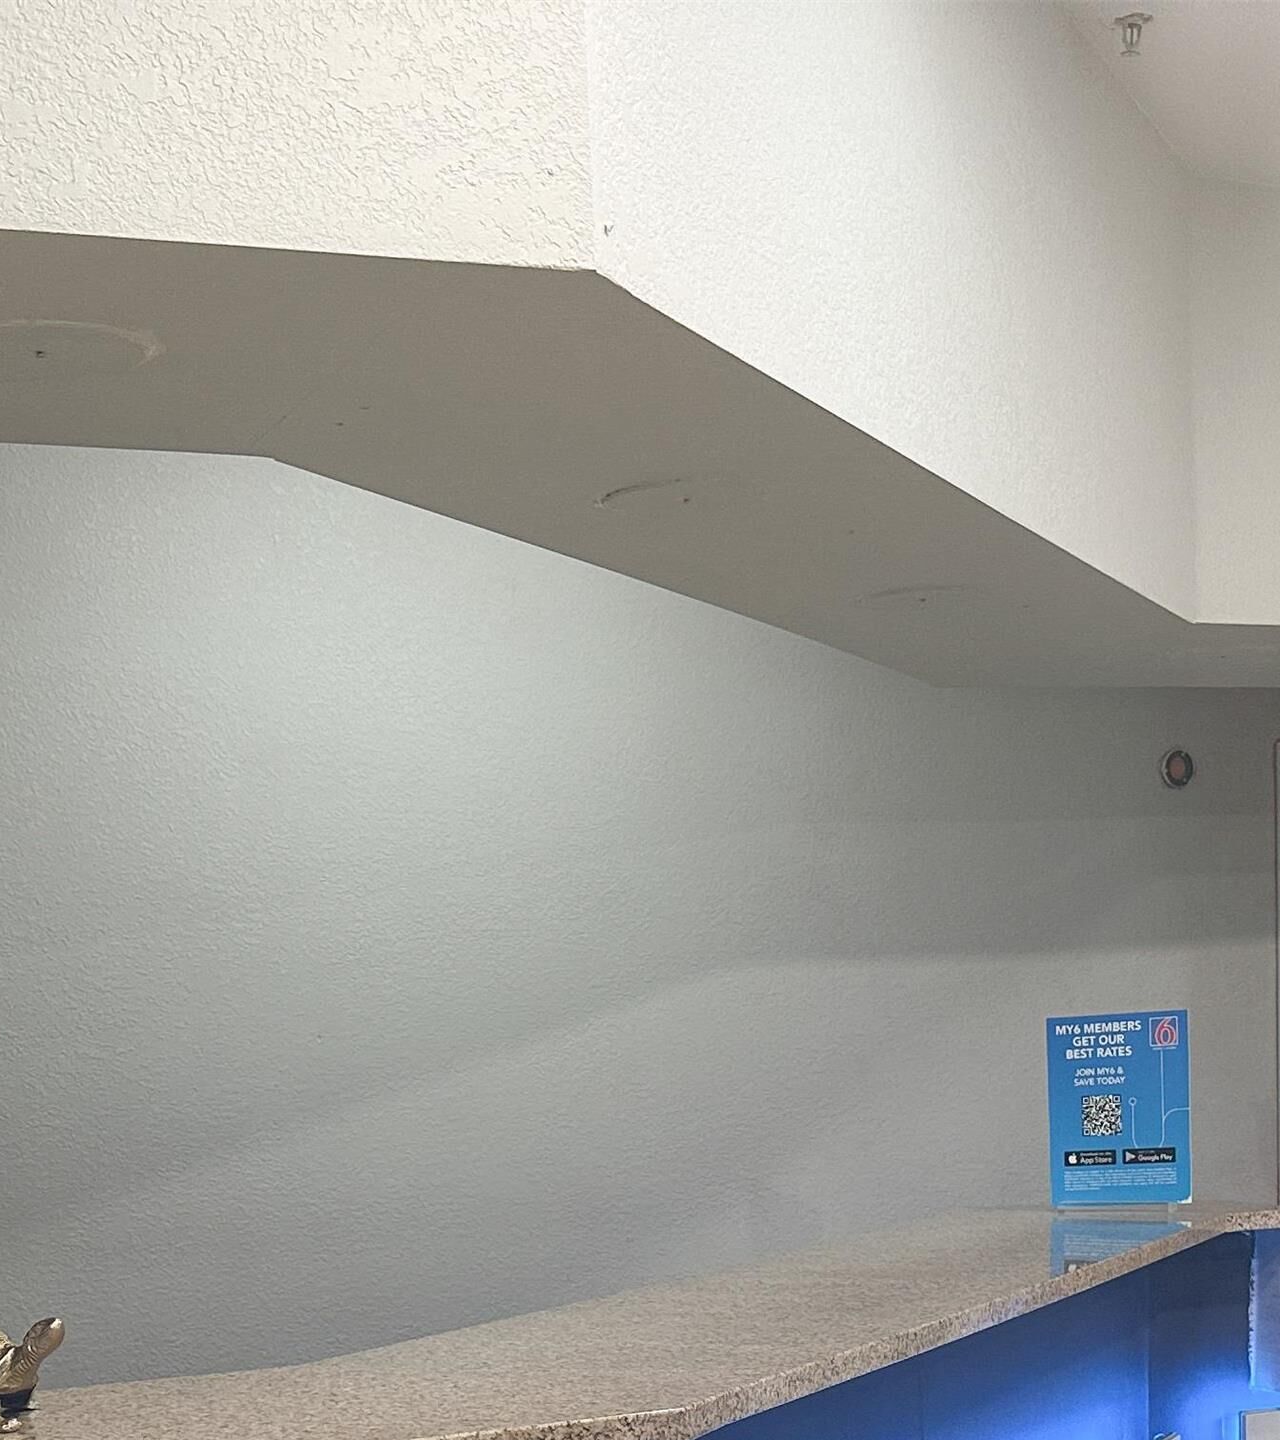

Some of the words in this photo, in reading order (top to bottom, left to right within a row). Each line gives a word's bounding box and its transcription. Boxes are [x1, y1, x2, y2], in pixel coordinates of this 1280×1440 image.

[1055, 1024, 1081, 1036] MY6
[1084, 1020, 1142, 1034] MEMBERS
[1155, 1018, 1177, 1046] 6
[1072, 1036, 1096, 1047] GET
[1098, 1034, 1125, 1045] OUR
[1065, 1048, 1094, 1060] BEST
[1096, 1046, 1133, 1058] RATES
[1075, 1067, 1095, 1077] JOIN
[1096, 1067, 1116, 1076] MY6
[1117, 1066, 1124, 1074] &
[1074, 1077, 1095, 1087] SAVE
[1096, 1076, 1126, 1085] TODAY
[1080, 1157, 1094, 1165] App
